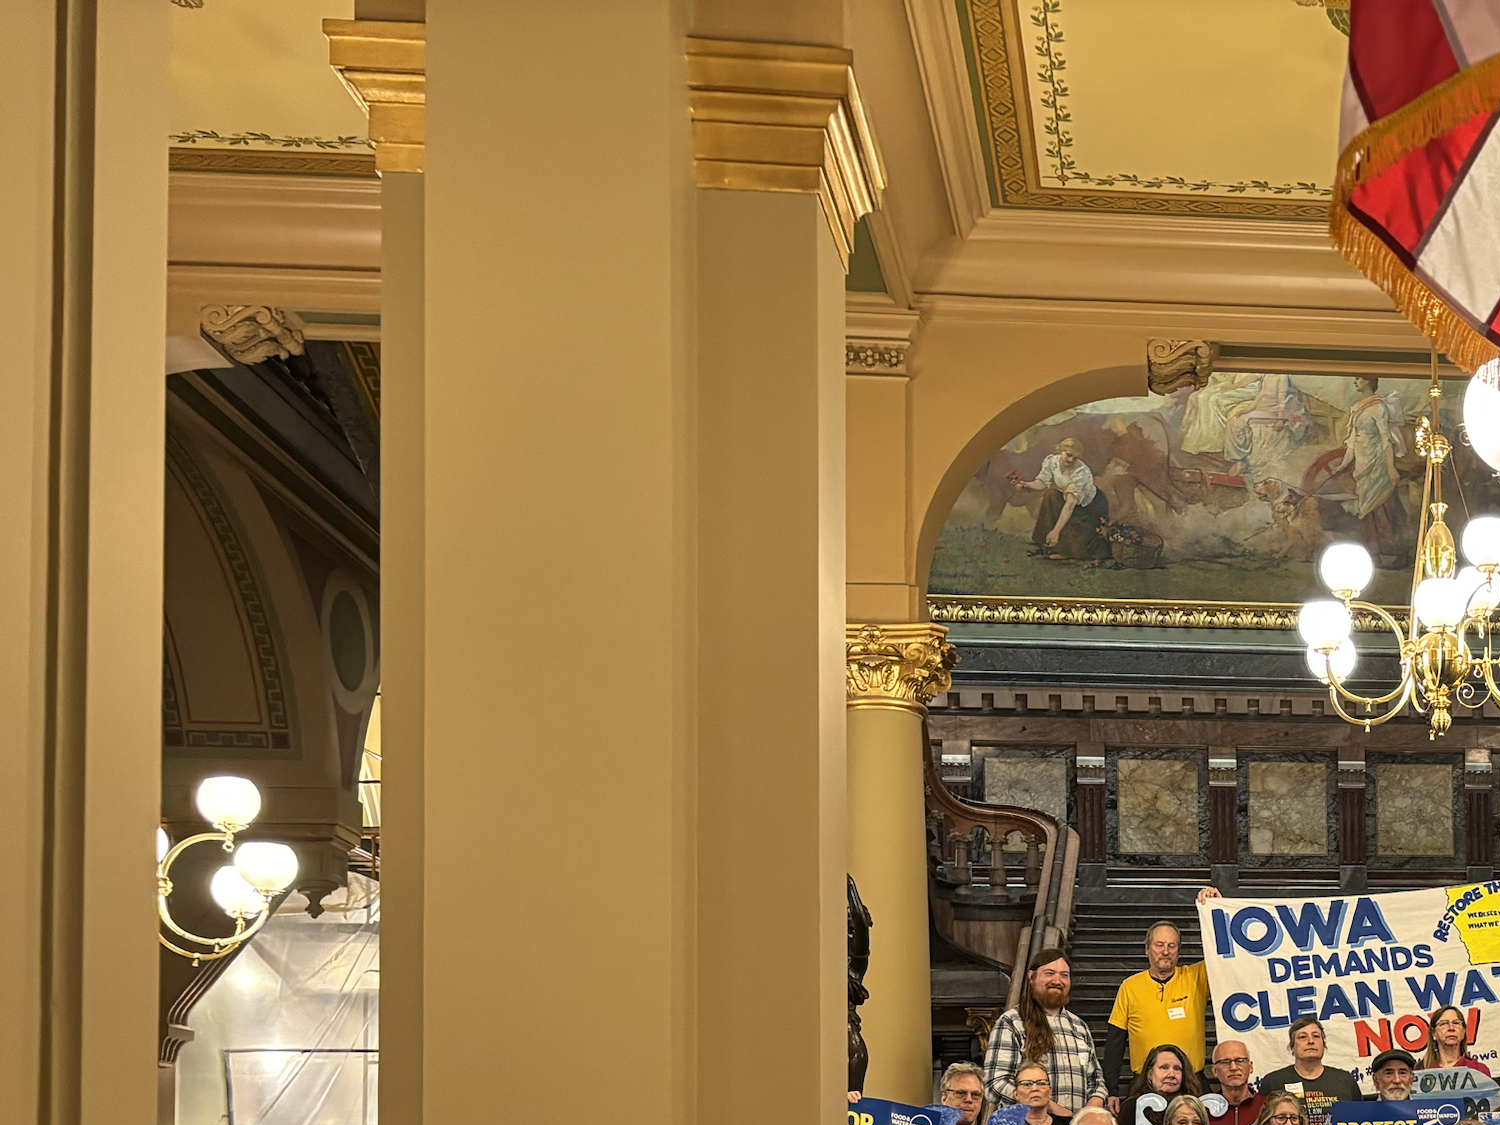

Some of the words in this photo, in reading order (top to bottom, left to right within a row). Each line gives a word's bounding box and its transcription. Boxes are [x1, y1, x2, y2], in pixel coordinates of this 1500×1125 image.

[1212, 898, 1398, 958] IOWA
[1433, 887, 1483, 942] RESTORE
[1467, 921, 1487, 930] WHAT
[1268, 943, 1434, 984] DEMANDS
[1221, 980, 1394, 1032] CLEAN
